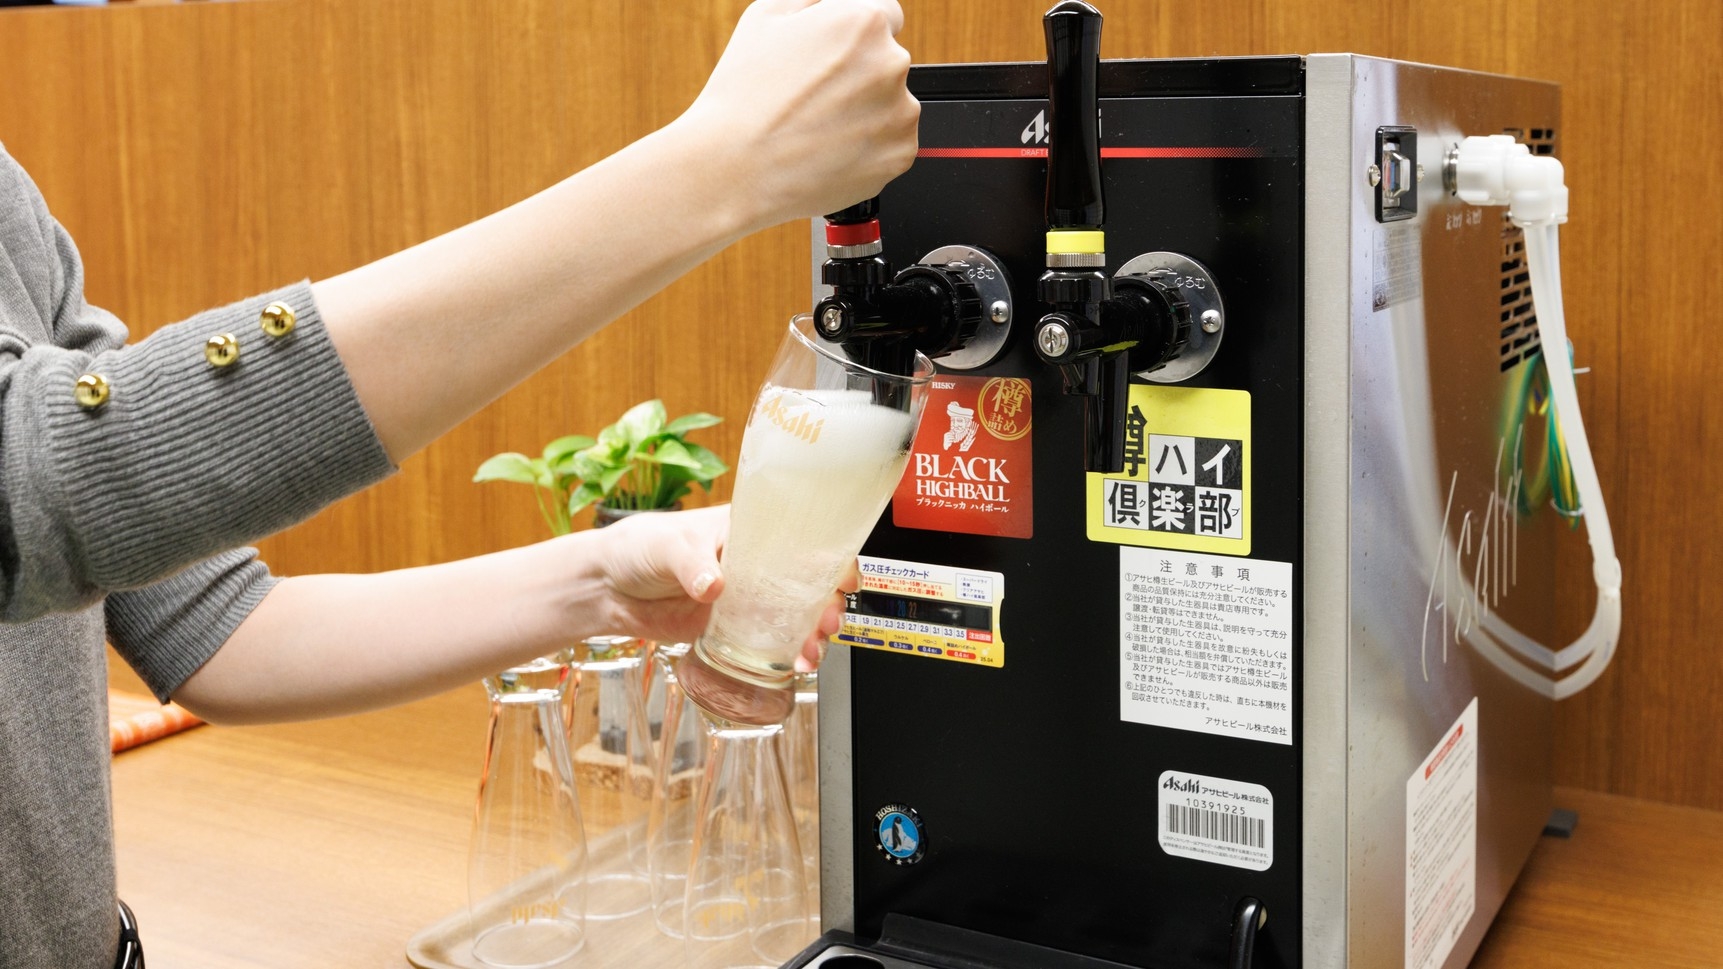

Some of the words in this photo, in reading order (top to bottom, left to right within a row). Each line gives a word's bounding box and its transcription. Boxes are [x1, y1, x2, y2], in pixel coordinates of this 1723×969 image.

[931, 381, 956, 390] HISKY
[991, 379, 1027, 418] 樽
[762, 395, 825, 445] Asahi
[914, 453, 1010, 484] BLACK
[916, 479, 1010, 502] HIGHBALL
[916, 498, 967, 510] ブラックニッカ
[970, 502, 1010, 513] ハイボール
[862, 563, 930, 579] ガス圧チェックカード
[1160, 560, 1250, 582] 注意事項
[846, 614, 857, 623] ス圧
[1205, 716, 1288, 736] アサヒビール株式会社
[1163, 776, 1200, 794] Asahi
[1201, 787, 1269, 805] アサヒビール株式会社
[1186, 798, 1246, 815] 10391925
